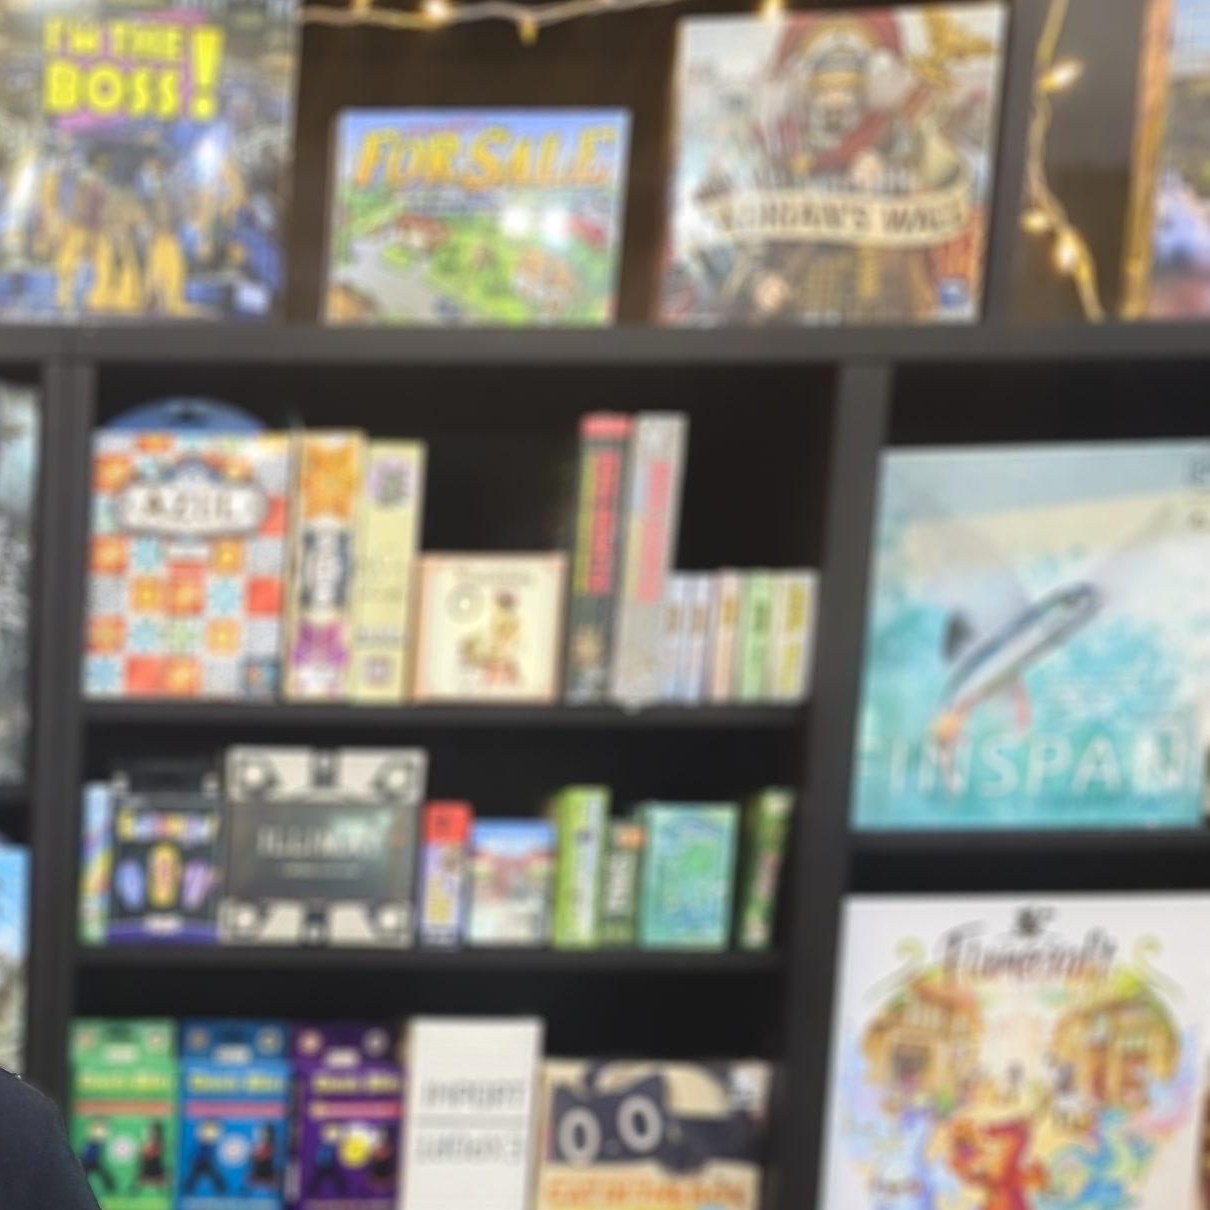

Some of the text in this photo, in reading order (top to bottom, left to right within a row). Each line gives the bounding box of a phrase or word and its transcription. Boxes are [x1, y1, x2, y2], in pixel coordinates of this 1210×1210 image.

[111, 23, 182, 60] THE
[353, 125, 619, 190] FOR SALE
